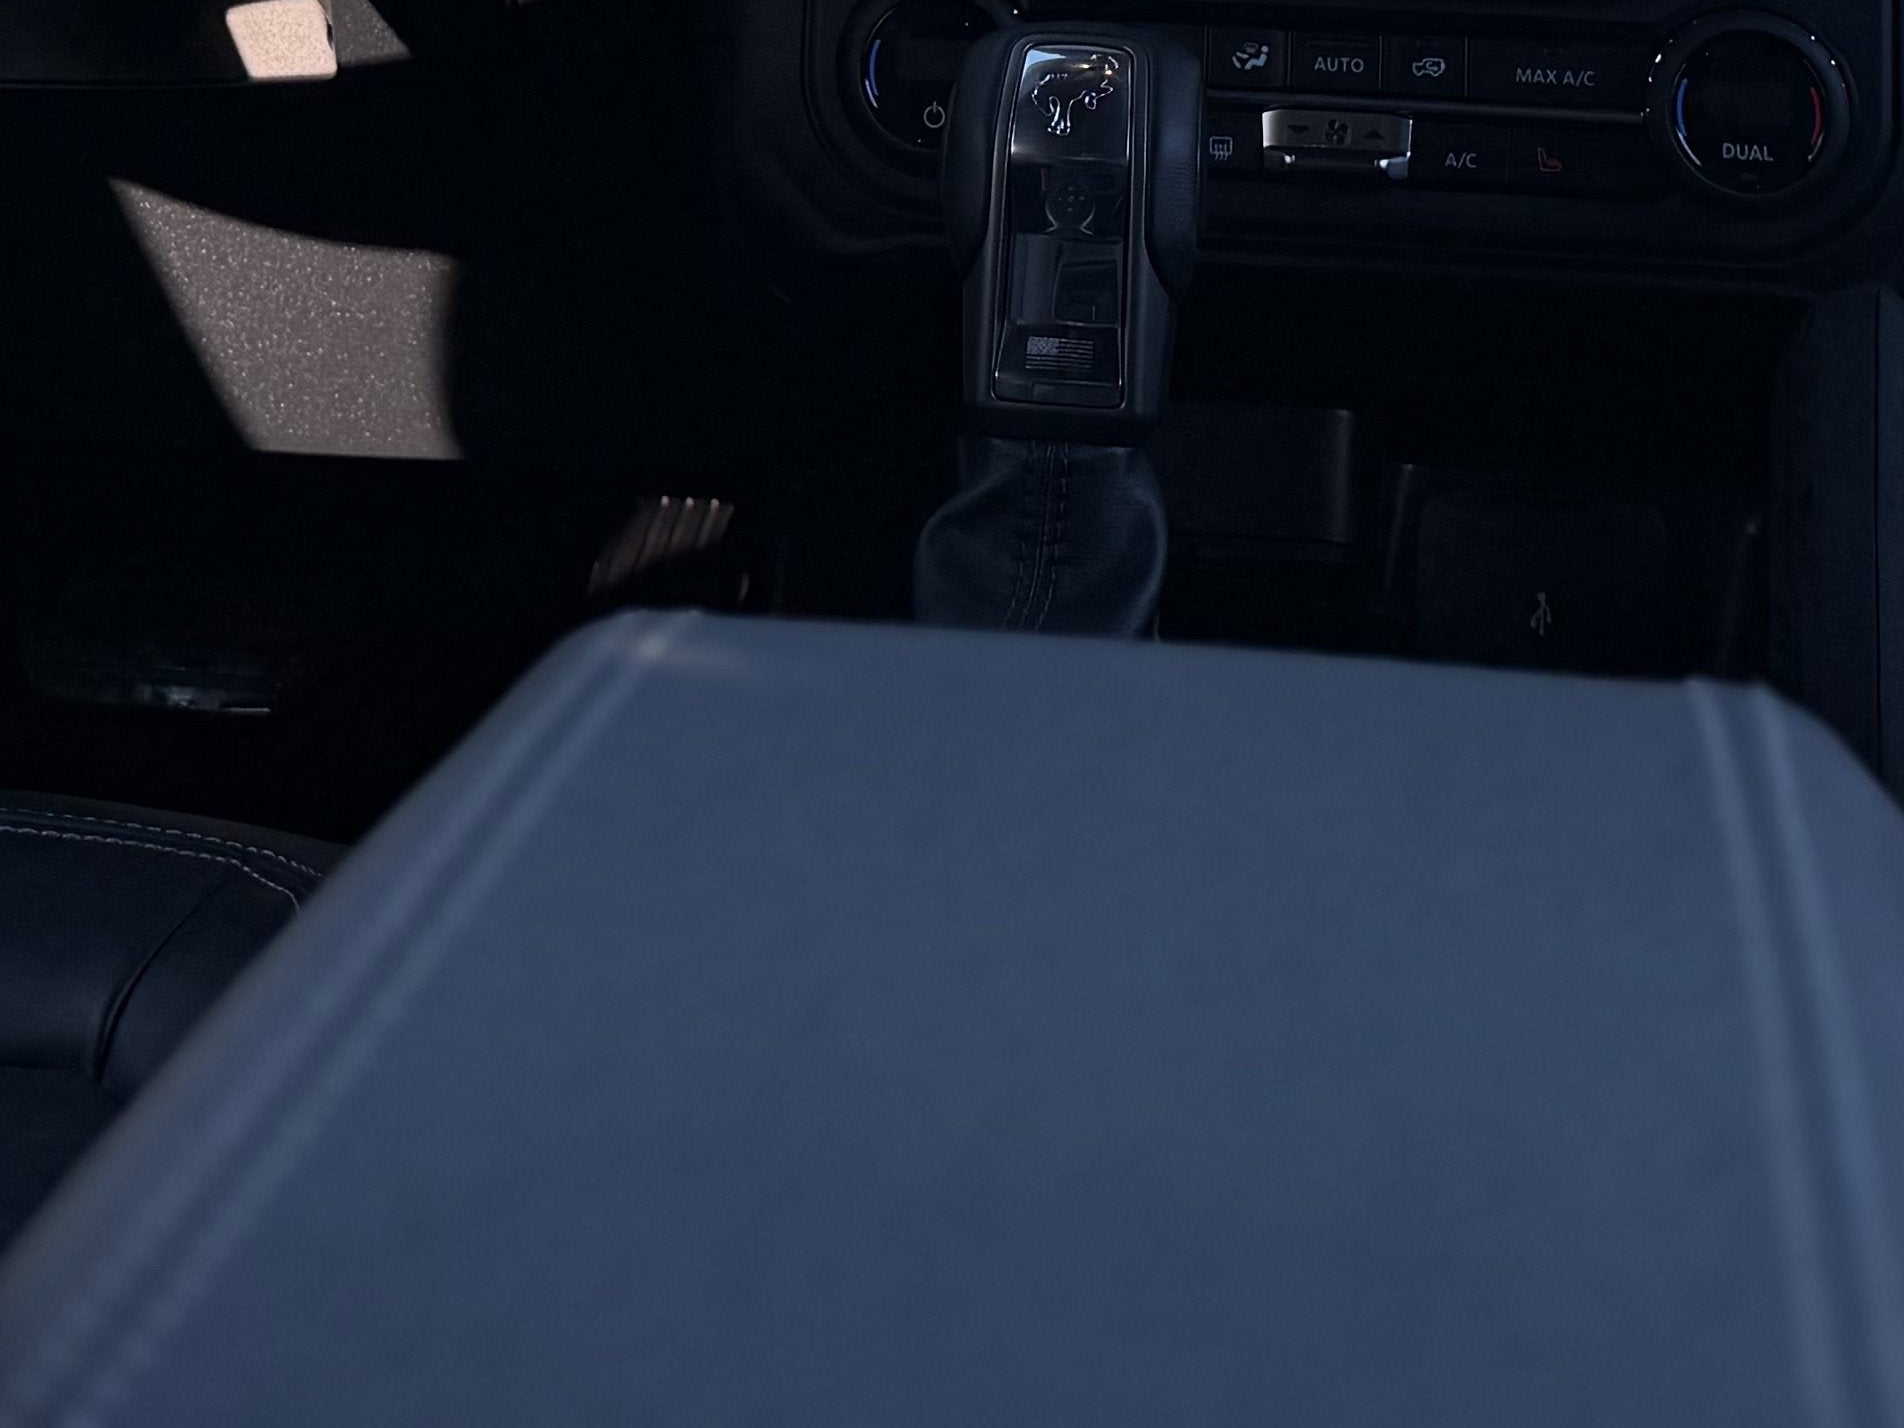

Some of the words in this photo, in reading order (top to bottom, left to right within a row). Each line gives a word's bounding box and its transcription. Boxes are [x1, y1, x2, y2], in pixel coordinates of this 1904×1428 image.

[1313, 55, 1366, 75] AUTO
[1514, 67, 1558, 87] MAX
[1562, 68, 1597, 90] A/C
[1444, 151, 1479, 171] A/C
[1721, 141, 1776, 164] DUAL
